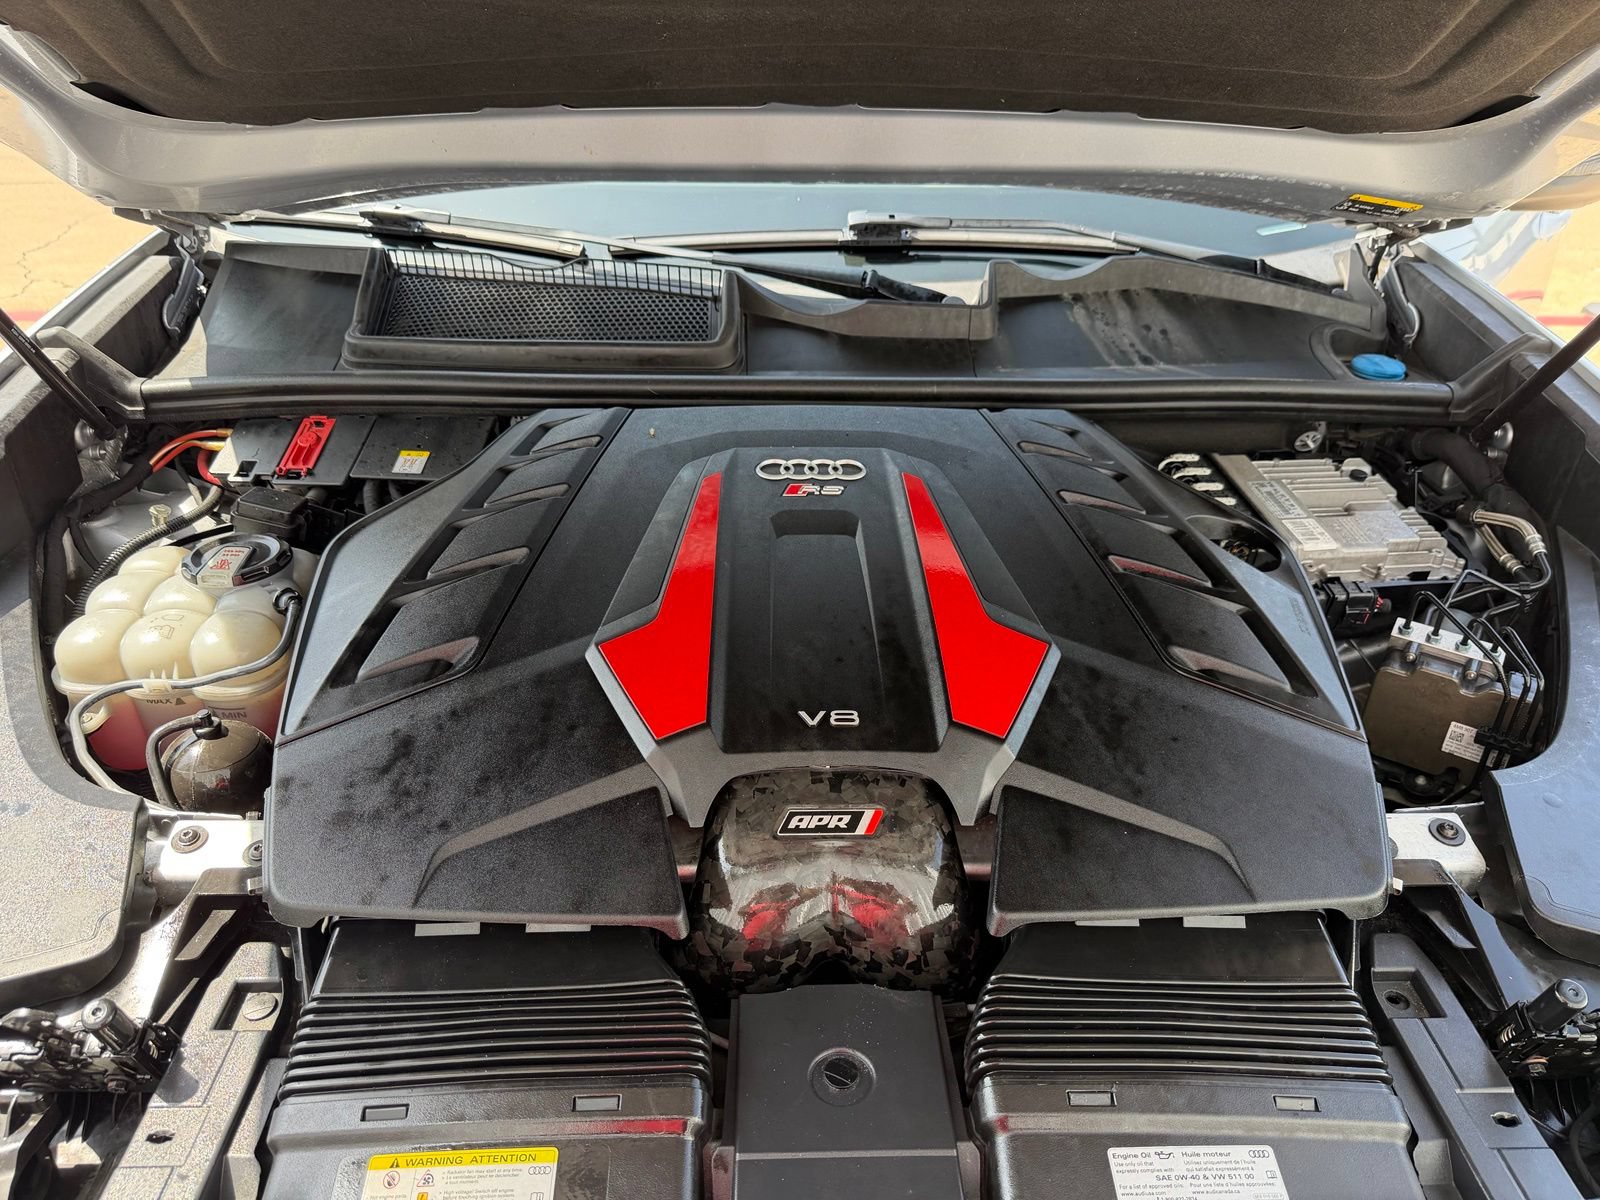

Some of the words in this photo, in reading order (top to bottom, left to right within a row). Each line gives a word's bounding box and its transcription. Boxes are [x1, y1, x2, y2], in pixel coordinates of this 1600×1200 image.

[795, 485, 845, 496] RS
[222, 711, 247, 719] MIN
[798, 710, 859, 727] V8
[787, 815, 852, 829] APR
[405, 1156, 463, 1167] WARNING
[470, 1153, 537, 1164] ATTENTION
[1112, 1152, 1139, 1160] Engine
